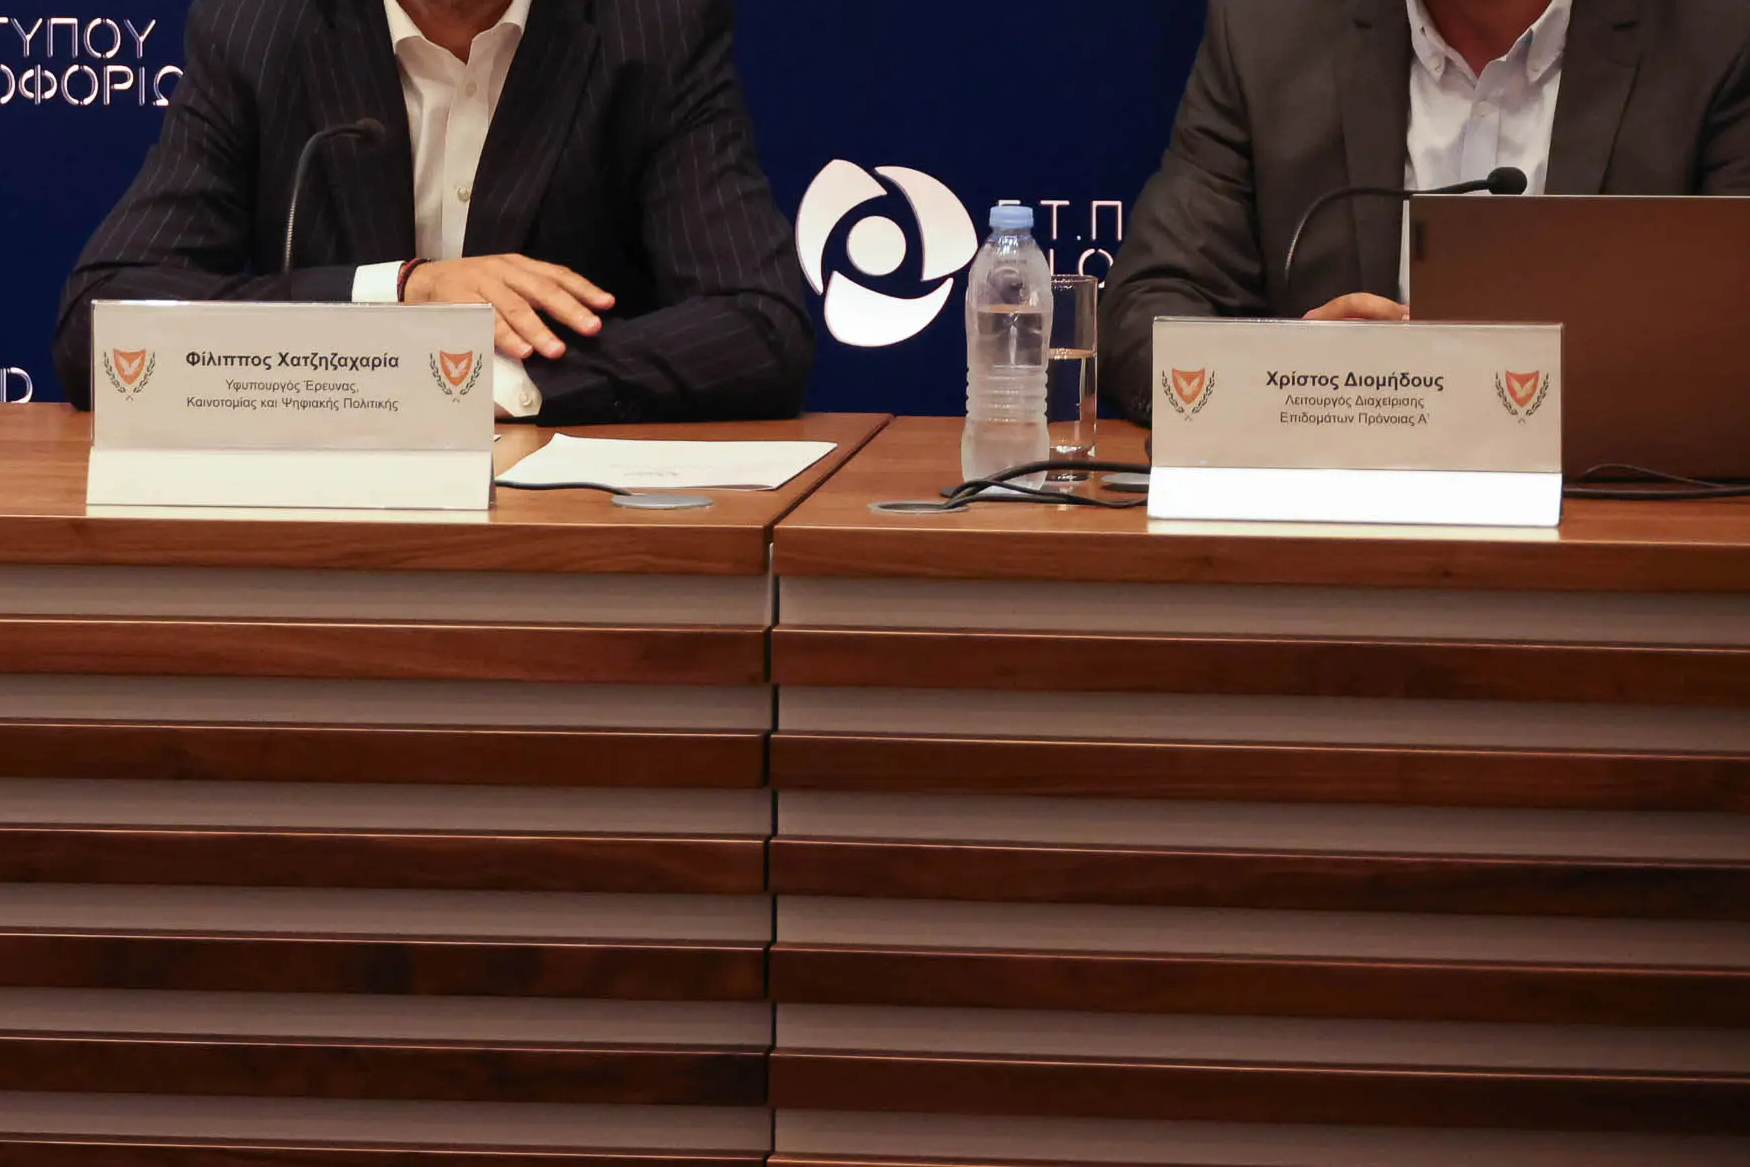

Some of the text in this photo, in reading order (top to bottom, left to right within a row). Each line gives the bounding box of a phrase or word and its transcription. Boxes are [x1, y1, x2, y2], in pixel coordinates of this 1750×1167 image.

[185, 351, 400, 371] Φίλιππος Χατζηζαχαρία
[225, 378, 300, 394] Υφυπουργός
[1265, 370, 1445, 392] Χρίστος Διομήδους
[260, 399, 278, 408] και
[281, 397, 340, 411] Ψηφιακής
[343, 397, 399, 412] Πολιτικής
[1285, 394, 1353, 409] Λειτουργός
[1279, 411, 1355, 426] Επιδομάτων
[1358, 412, 1416, 427] Πρόνοιας
